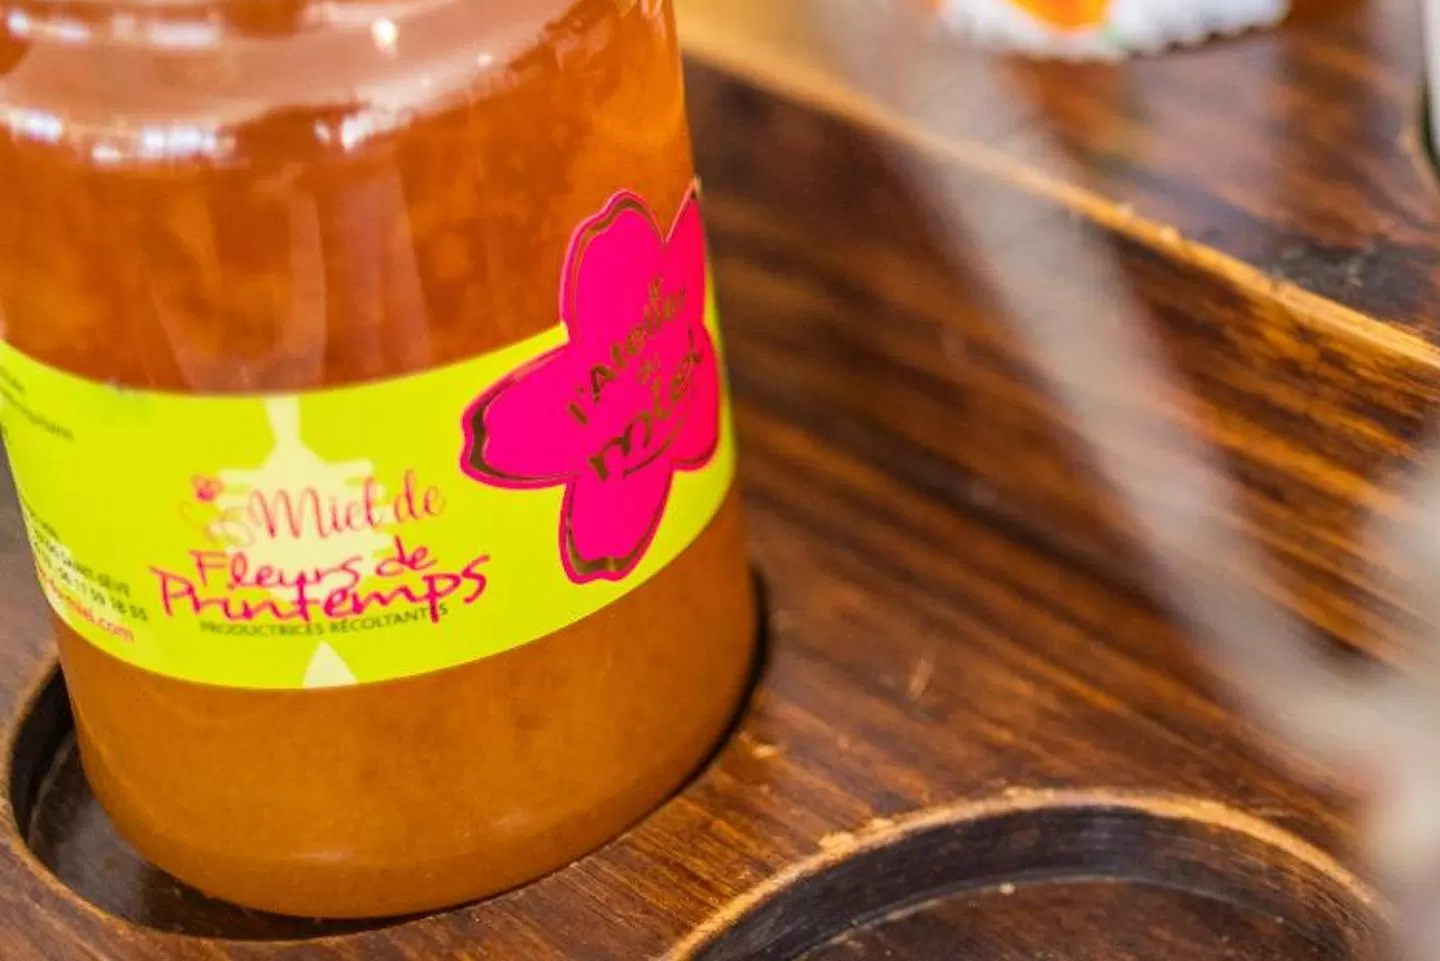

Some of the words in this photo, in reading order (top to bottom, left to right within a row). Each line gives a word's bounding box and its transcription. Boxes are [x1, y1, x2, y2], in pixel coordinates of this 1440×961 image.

[248, 477, 382, 538] Miel
[393, 470, 444, 522] de
[149, 555, 490, 623] Printemps
[189, 549, 363, 590] Fleurs
[375, 535, 438, 577] de
[329, 603, 449, 635] RÉCOLTANTS
